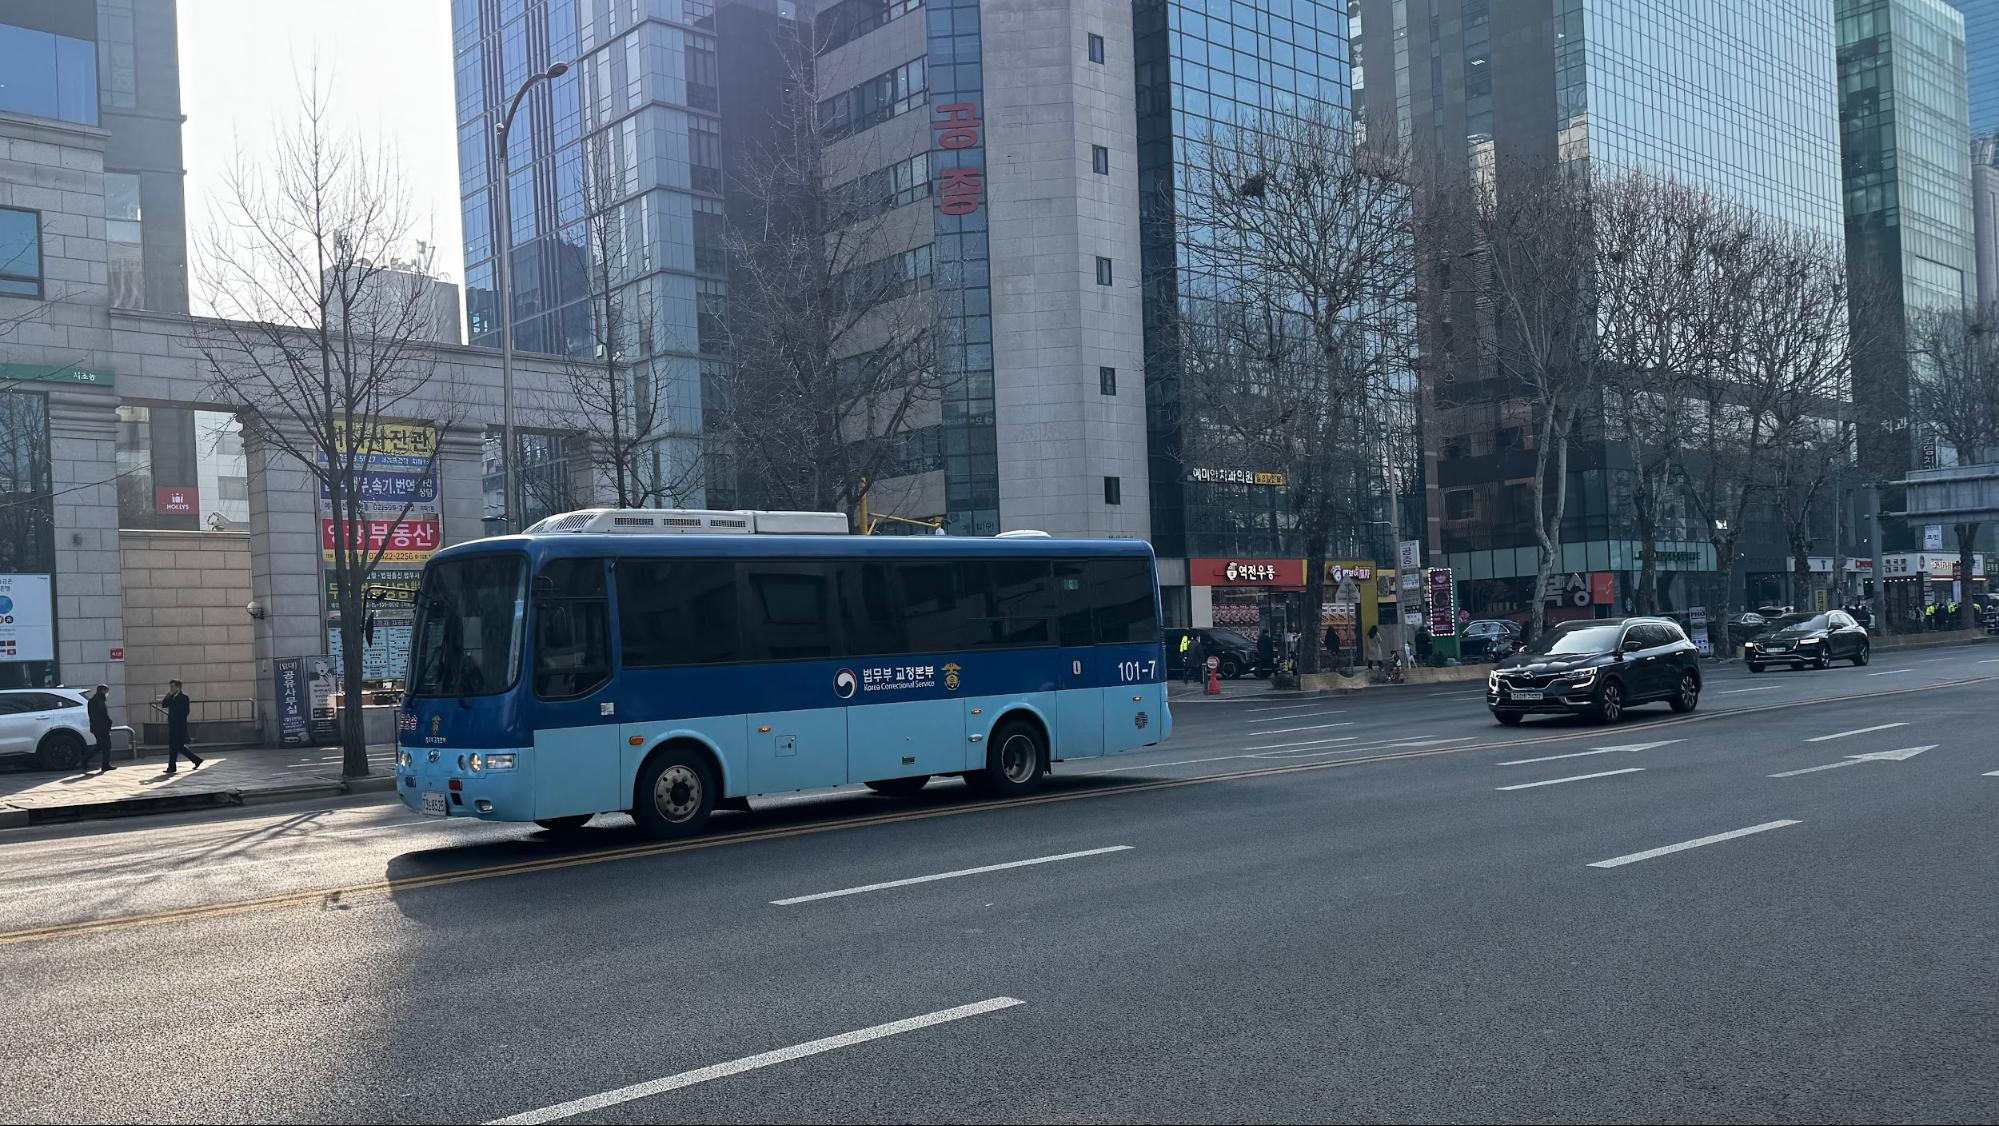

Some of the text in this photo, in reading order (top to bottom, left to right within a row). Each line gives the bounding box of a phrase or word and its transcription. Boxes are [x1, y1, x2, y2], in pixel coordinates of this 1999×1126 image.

[1238, 564, 1276, 581] 역전우동
[863, 665, 934, 683] 법무부 교정본부
[1118, 660, 1157, 682] 101-7
[864, 680, 935, 691] Korea Correctional Service
